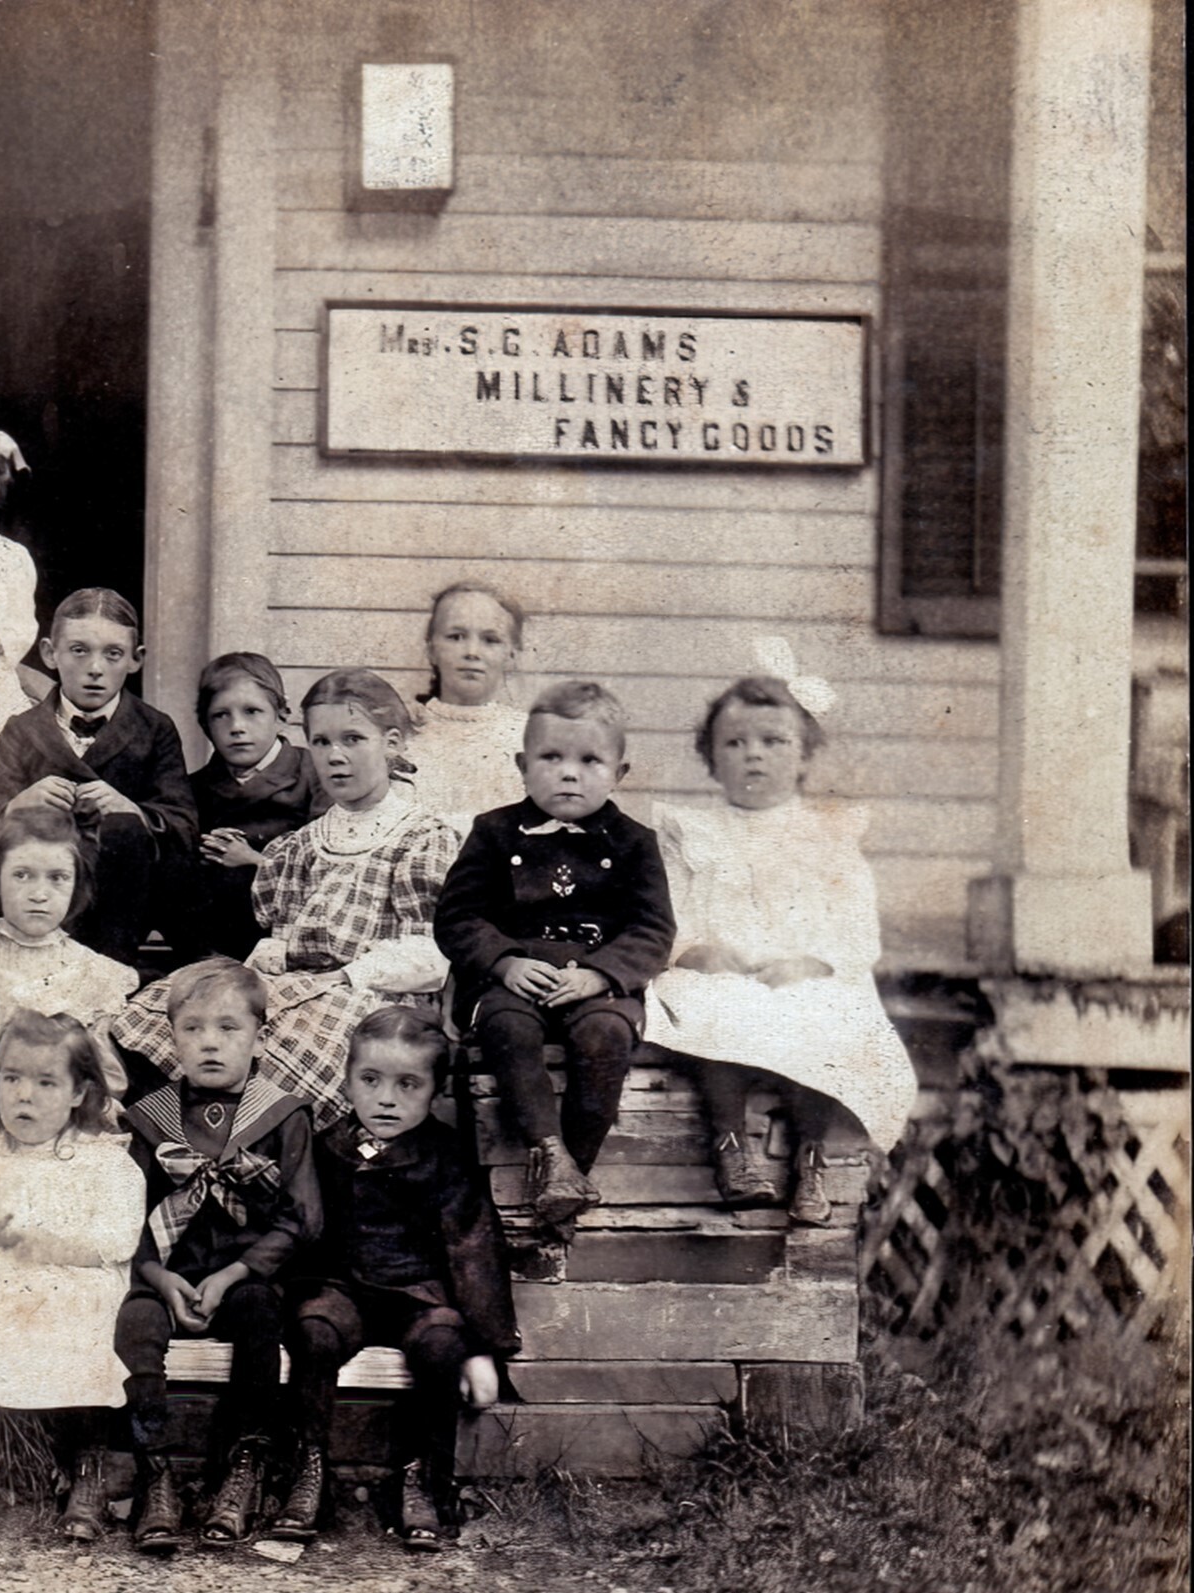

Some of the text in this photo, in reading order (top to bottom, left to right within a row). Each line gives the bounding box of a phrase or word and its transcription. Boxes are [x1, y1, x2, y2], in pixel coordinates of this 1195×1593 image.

[553, 328, 697, 362] ADAMS
[476, 371, 708, 408] MILLINERY
[554, 418, 834, 454] FANCY GOODS
